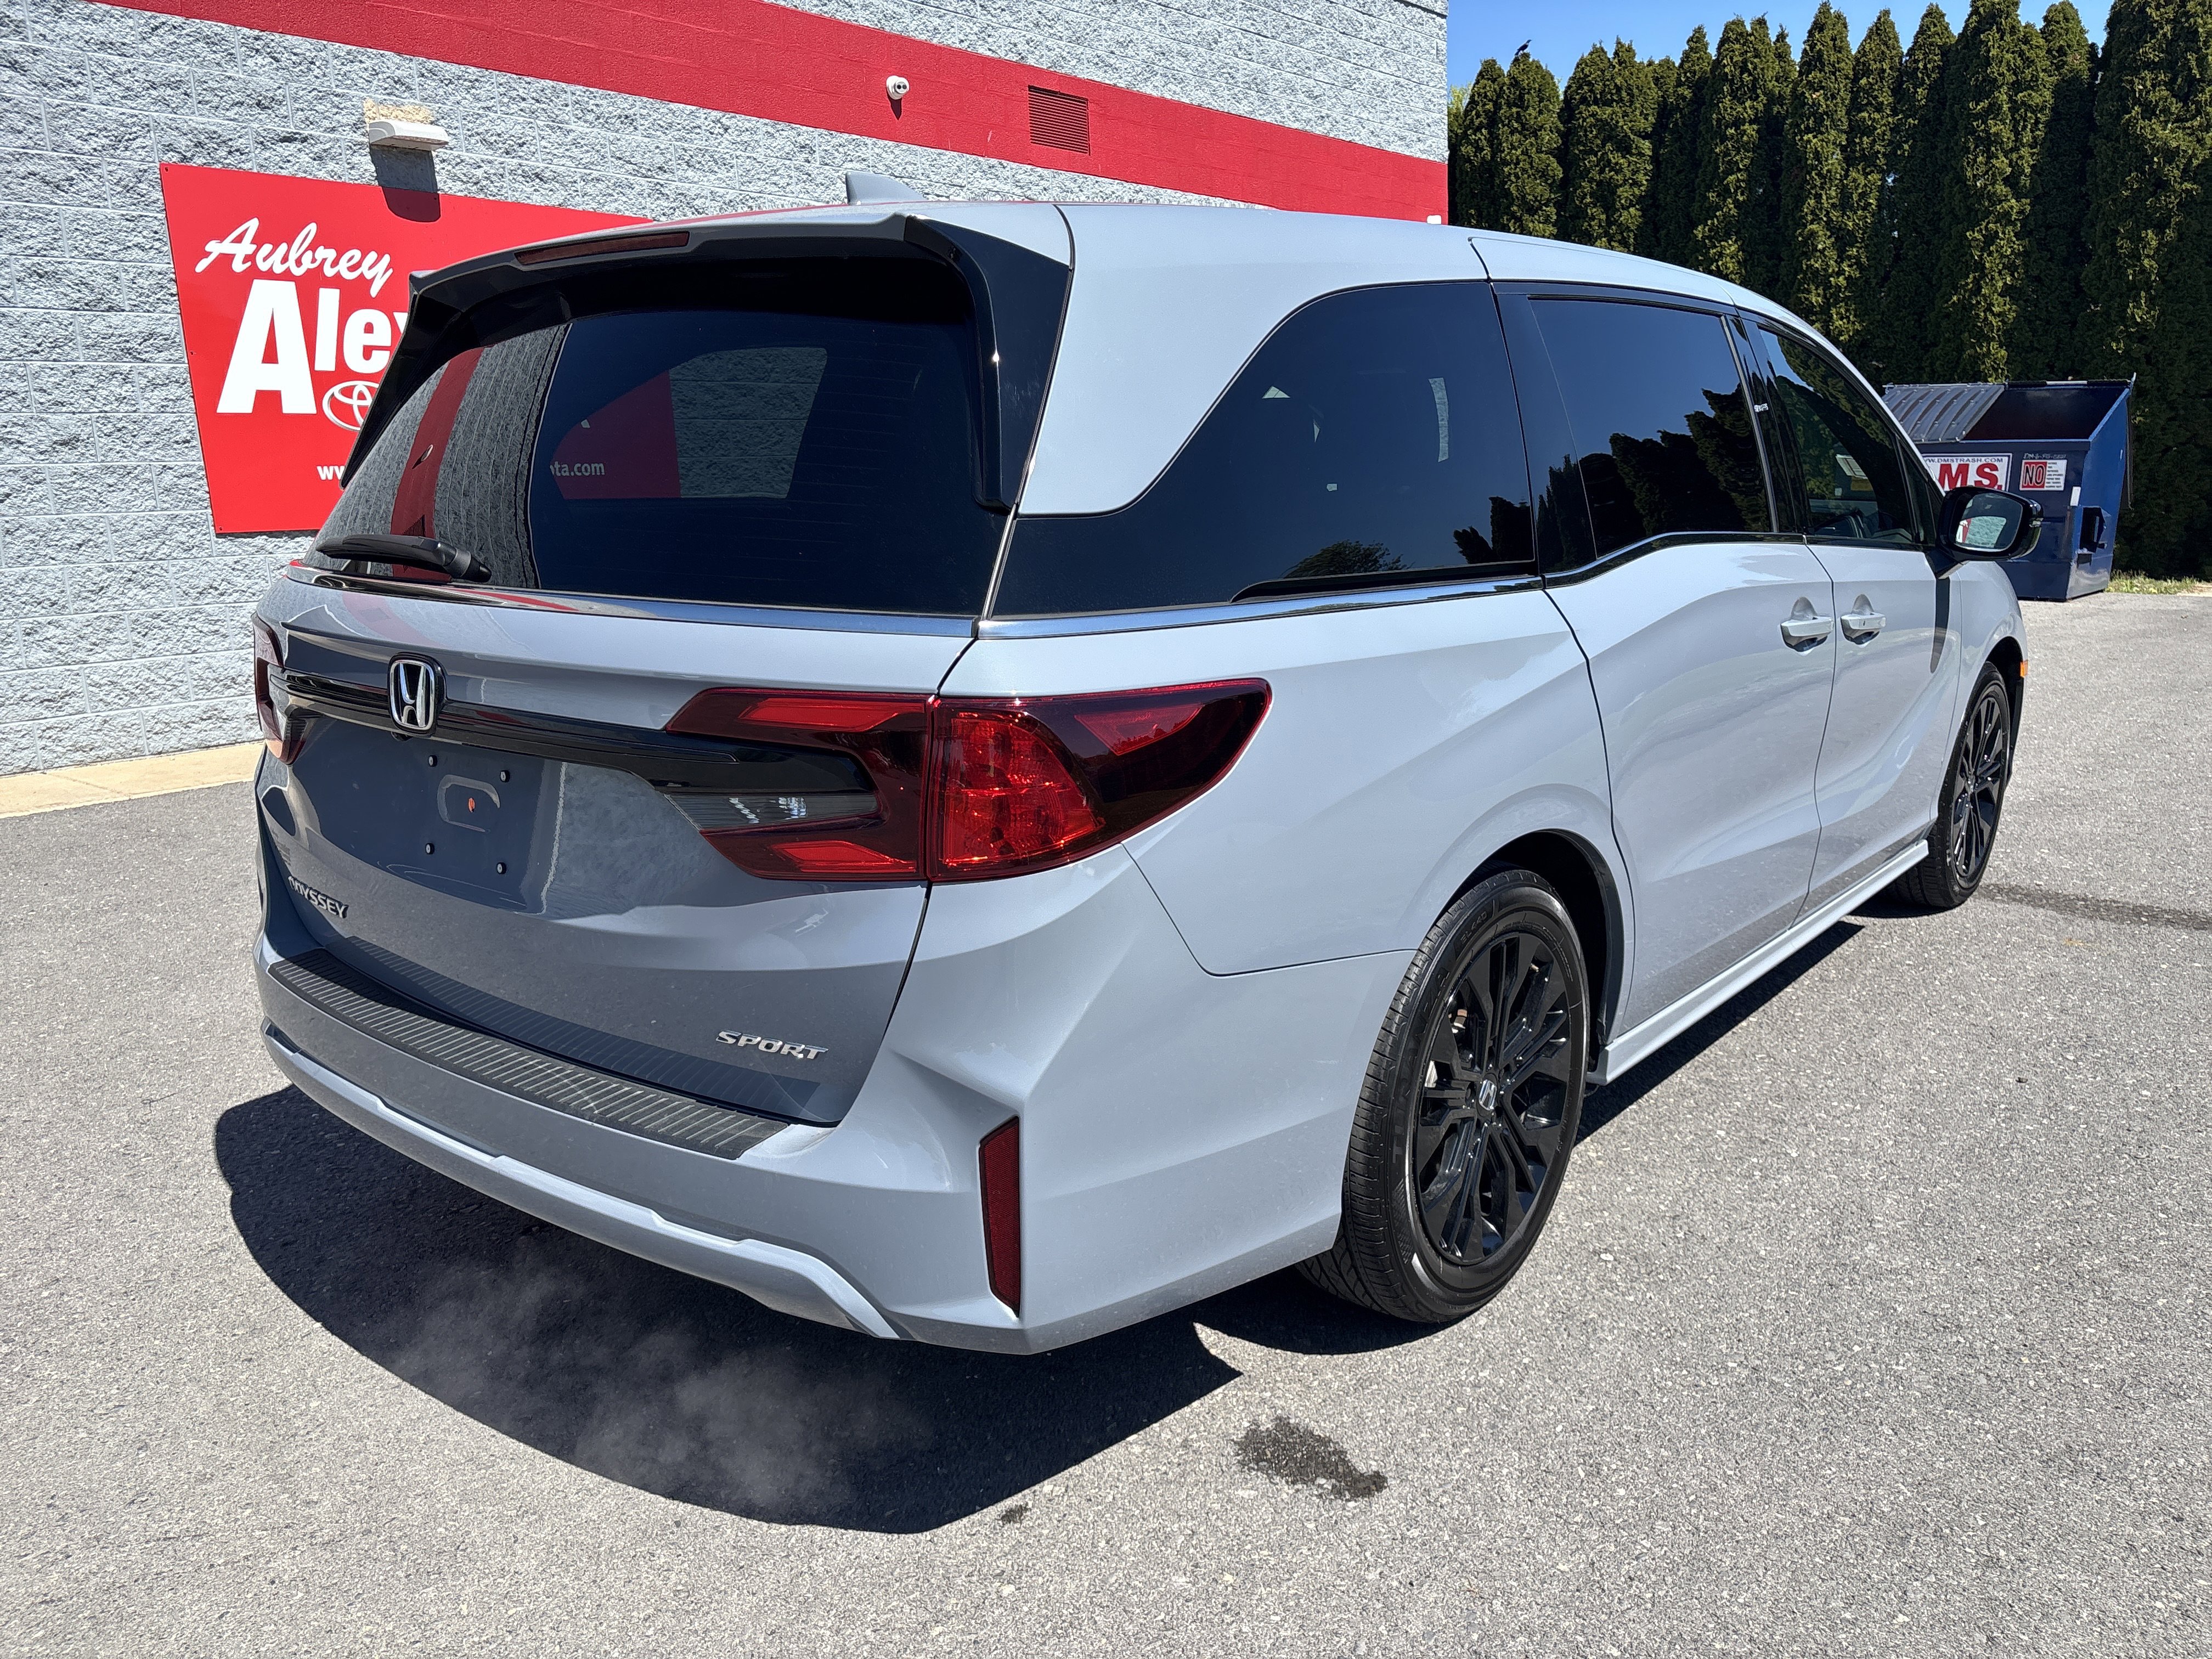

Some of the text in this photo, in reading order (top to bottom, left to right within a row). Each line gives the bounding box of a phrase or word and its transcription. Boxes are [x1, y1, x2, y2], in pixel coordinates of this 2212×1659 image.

[195, 217, 393, 297] Aubrey
[216, 279, 409, 414] Ale
[2023, 464, 2045, 486] NO
[288, 876, 349, 918] ODYSSEY
[715, 1030, 829, 1059] SPORT
